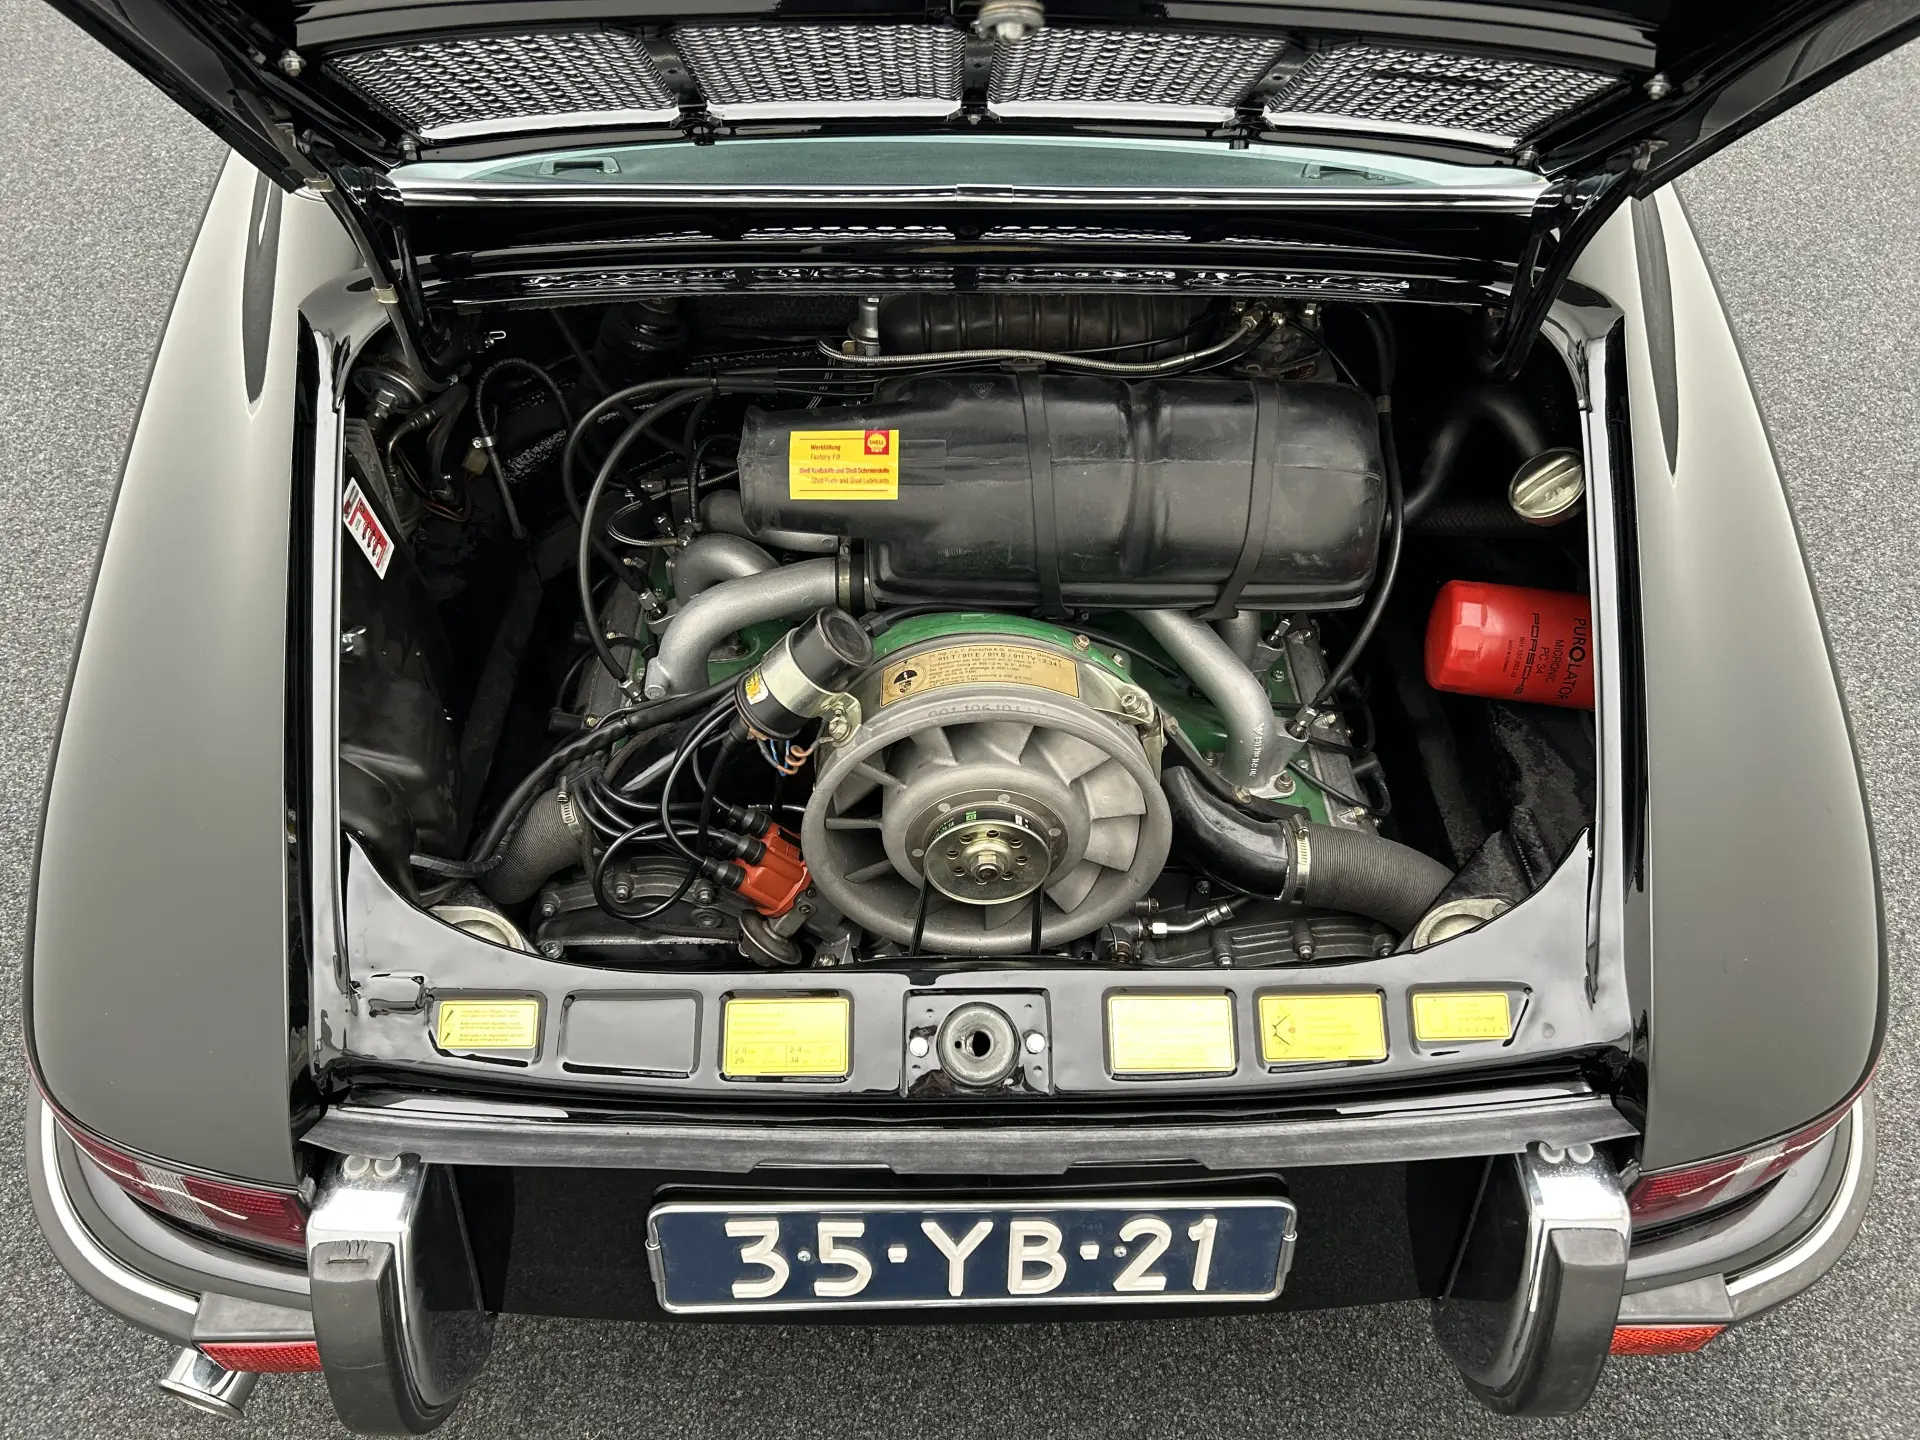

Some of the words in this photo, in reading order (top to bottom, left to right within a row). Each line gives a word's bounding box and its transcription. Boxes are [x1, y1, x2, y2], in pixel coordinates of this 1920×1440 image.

[1037, 653, 1061, 662] Germany
[1513, 612, 1540, 695] PORSCHE
[1536, 663, 1546, 674] 34
[1539, 647, 1550, 661] PC
[1545, 640, 1564, 684] MICRONIC
[1556, 617, 1587, 700] PUROLATOR
[725, 1216, 1218, 1298] 35-YB-21
